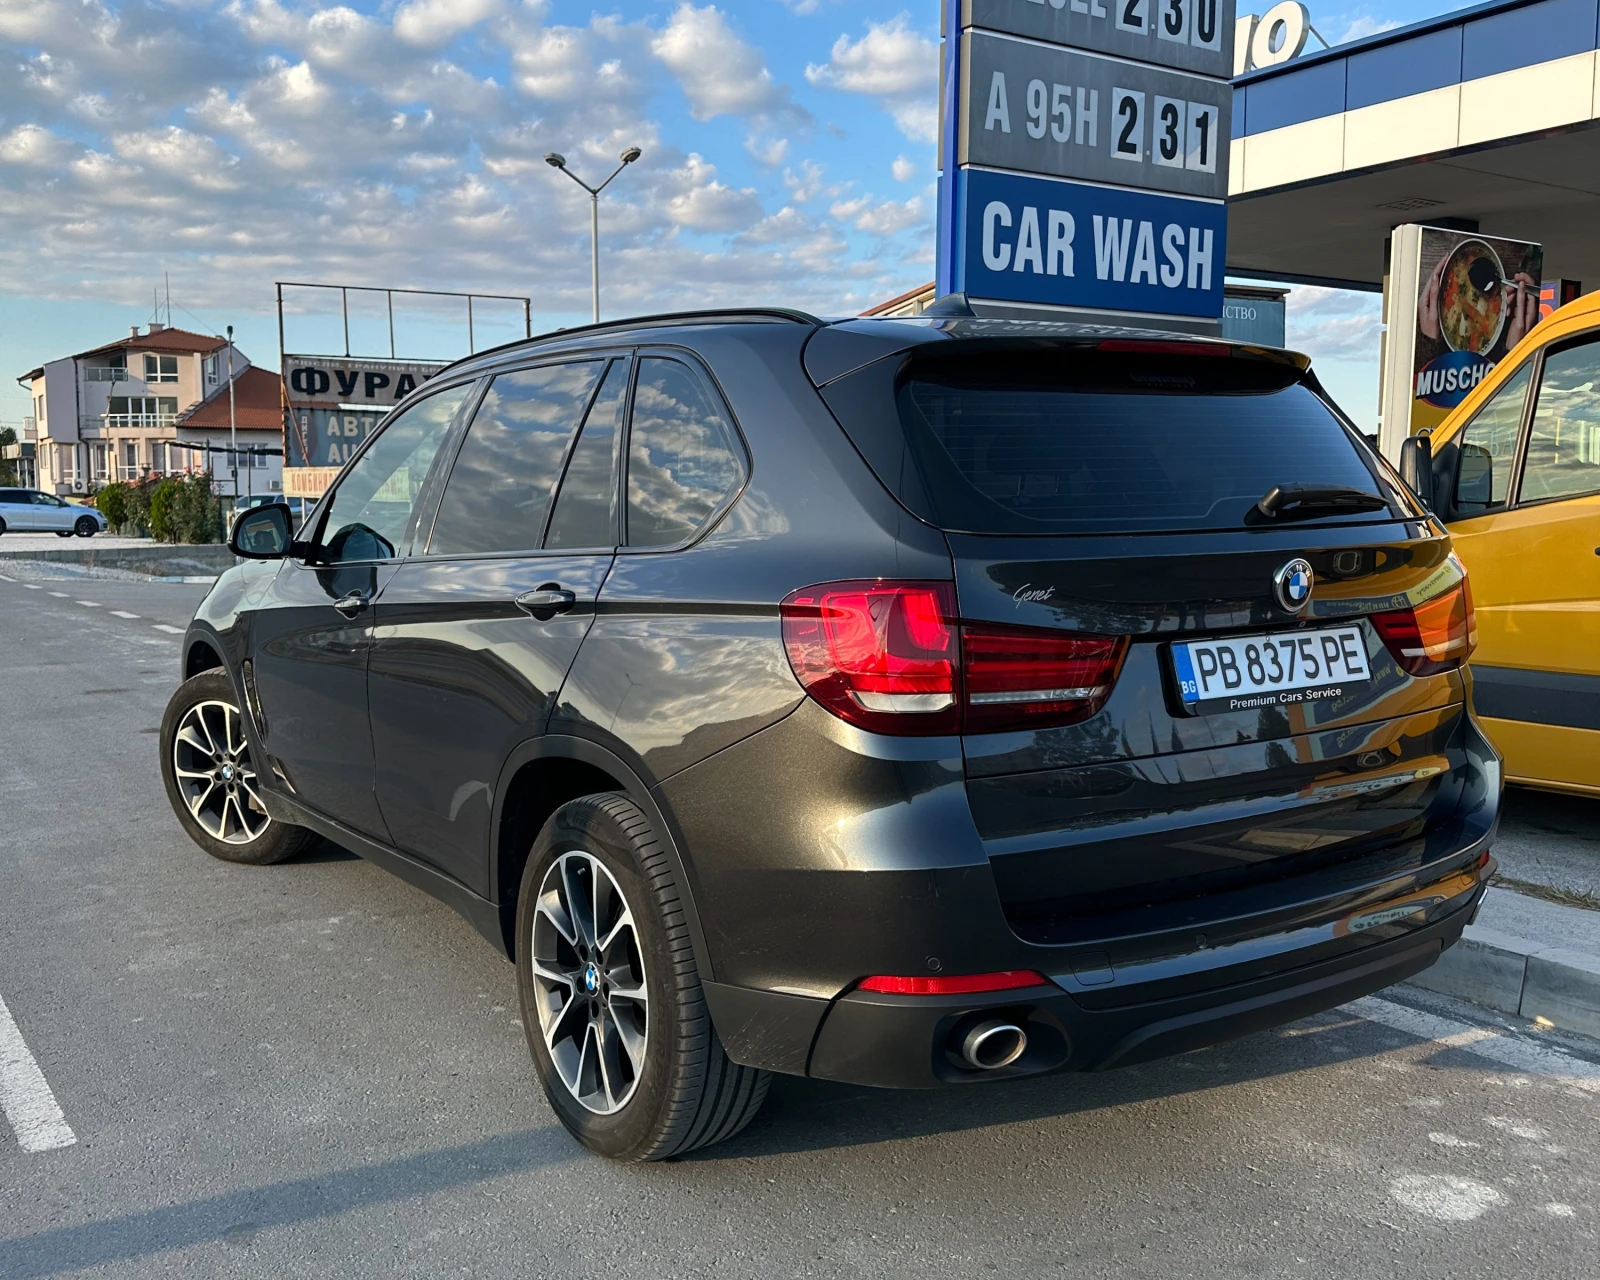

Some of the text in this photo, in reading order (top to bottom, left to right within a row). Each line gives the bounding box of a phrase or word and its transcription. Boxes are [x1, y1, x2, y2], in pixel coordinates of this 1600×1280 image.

[984, 70, 1209, 166] A 95H 2.31
[982, 200, 1214, 290] CAR WASH
[1012, 583, 1056, 609] Genet
[1195, 645, 1241, 692] PB
[1245, 637, 1320, 686] 8375
[1320, 634, 1364, 678] PE
[1182, 680, 1196, 694] BG
[1230, 687, 1342, 709] Premium Cars Service
